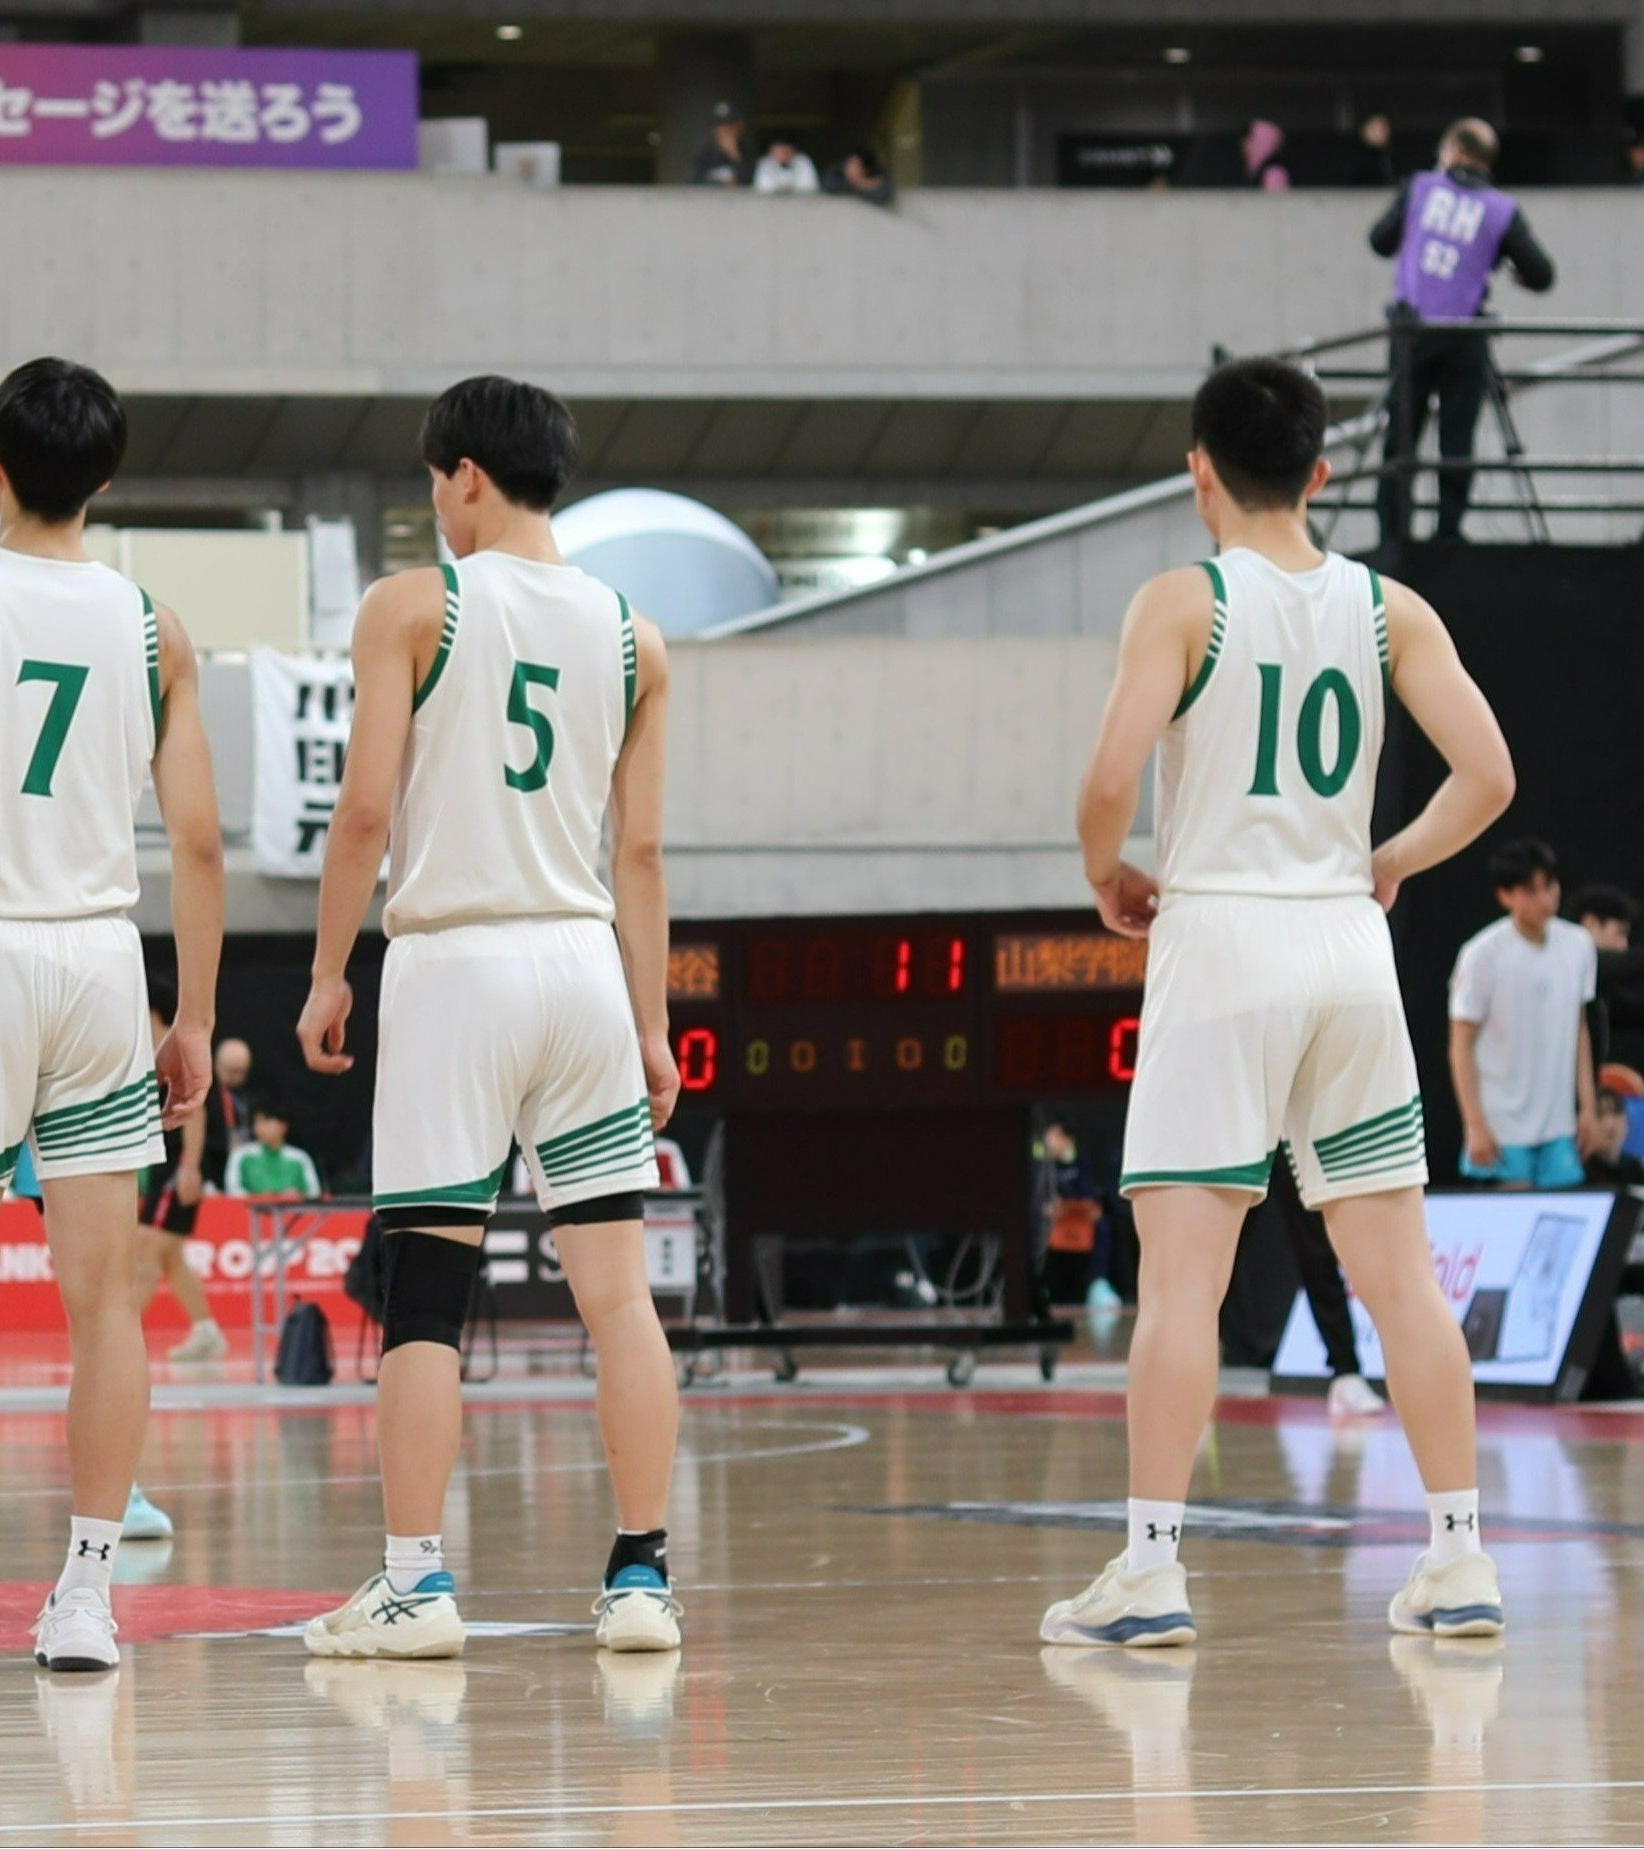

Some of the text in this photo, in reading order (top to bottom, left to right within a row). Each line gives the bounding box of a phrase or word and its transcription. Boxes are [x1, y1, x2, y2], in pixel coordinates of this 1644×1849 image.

[1421, 186, 1484, 245] RH
[16, 658, 91, 799] 7
[503, 660, 561, 793] 5
[1250, 662, 1360, 798] 10
[679, 1029, 717, 1091] 0
